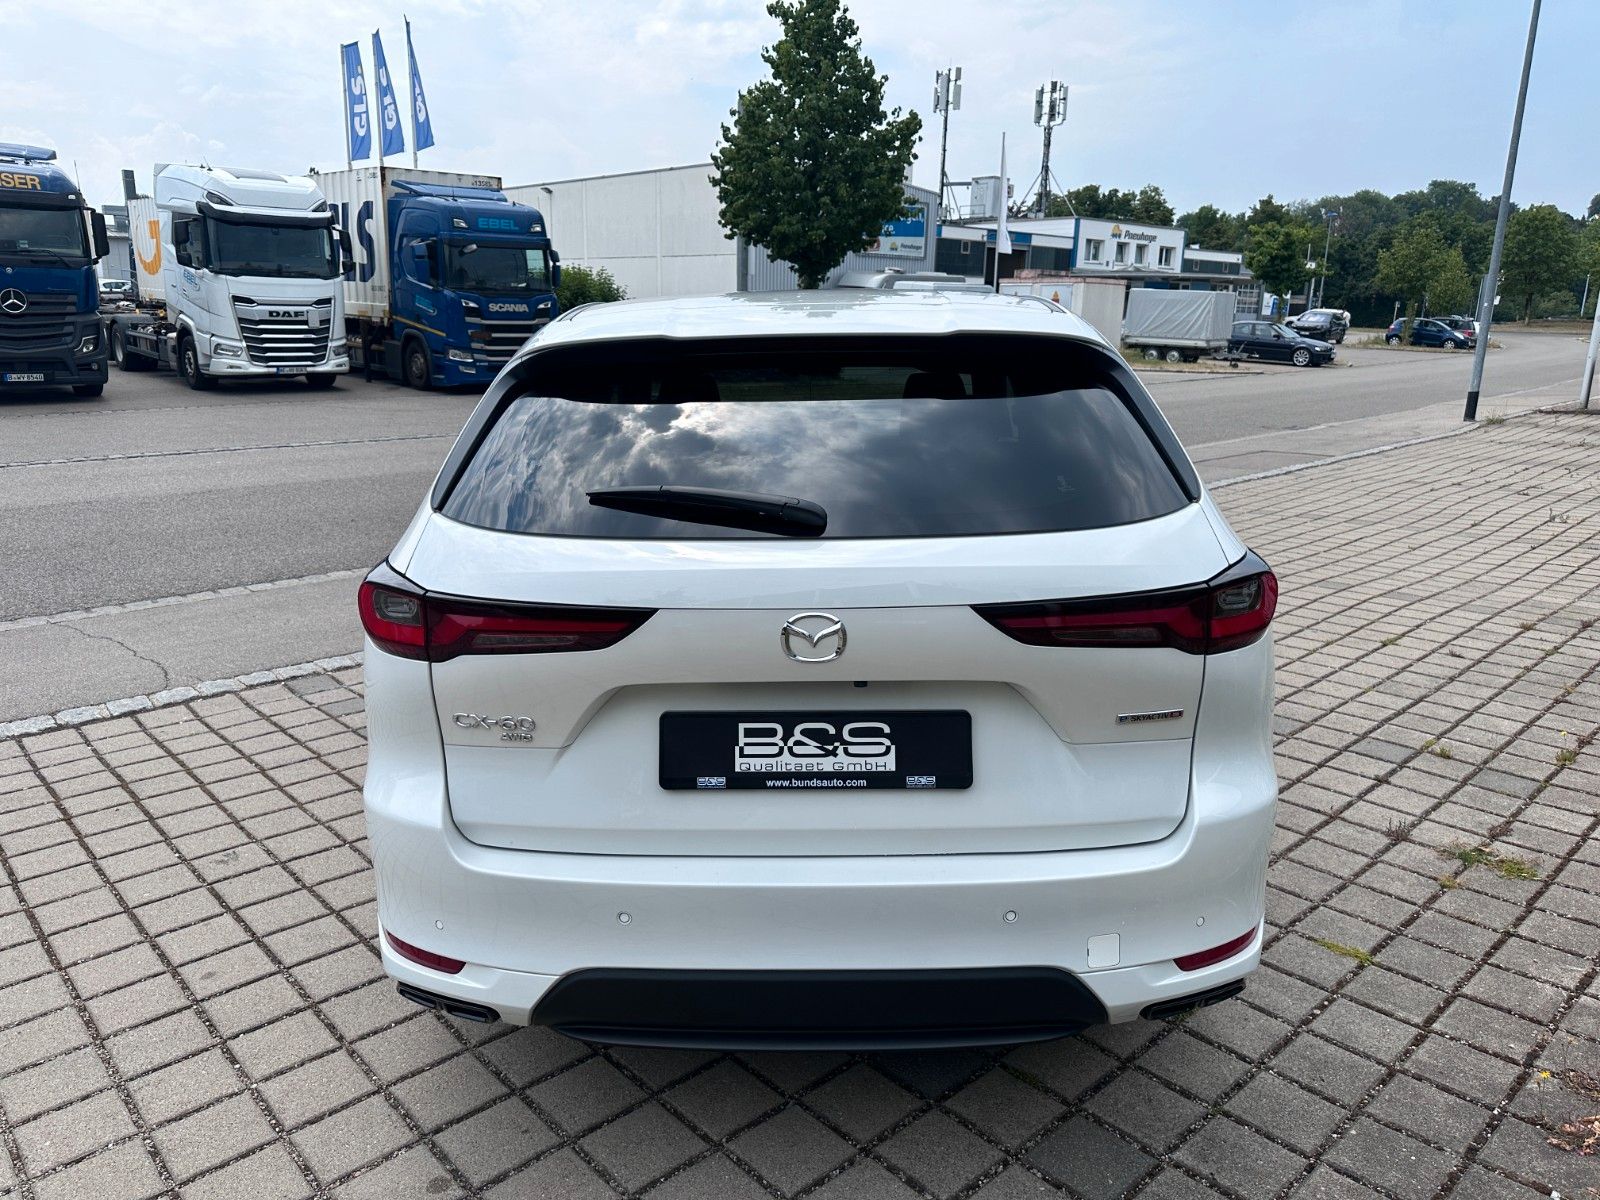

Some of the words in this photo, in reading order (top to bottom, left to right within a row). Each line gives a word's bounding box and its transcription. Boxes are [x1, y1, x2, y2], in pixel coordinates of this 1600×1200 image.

[478, 218, 519, 230] EBEL
[1124, 229, 1157, 243] Pneuhage
[488, 302, 529, 313] SCANIA
[268, 310, 304, 318] DAF
[452, 712, 536, 732] CX-60
[738, 721, 892, 759] B&S
[739, 760, 824, 772] Qualitaet
[766, 777, 867, 788] www.bundsauto.com
